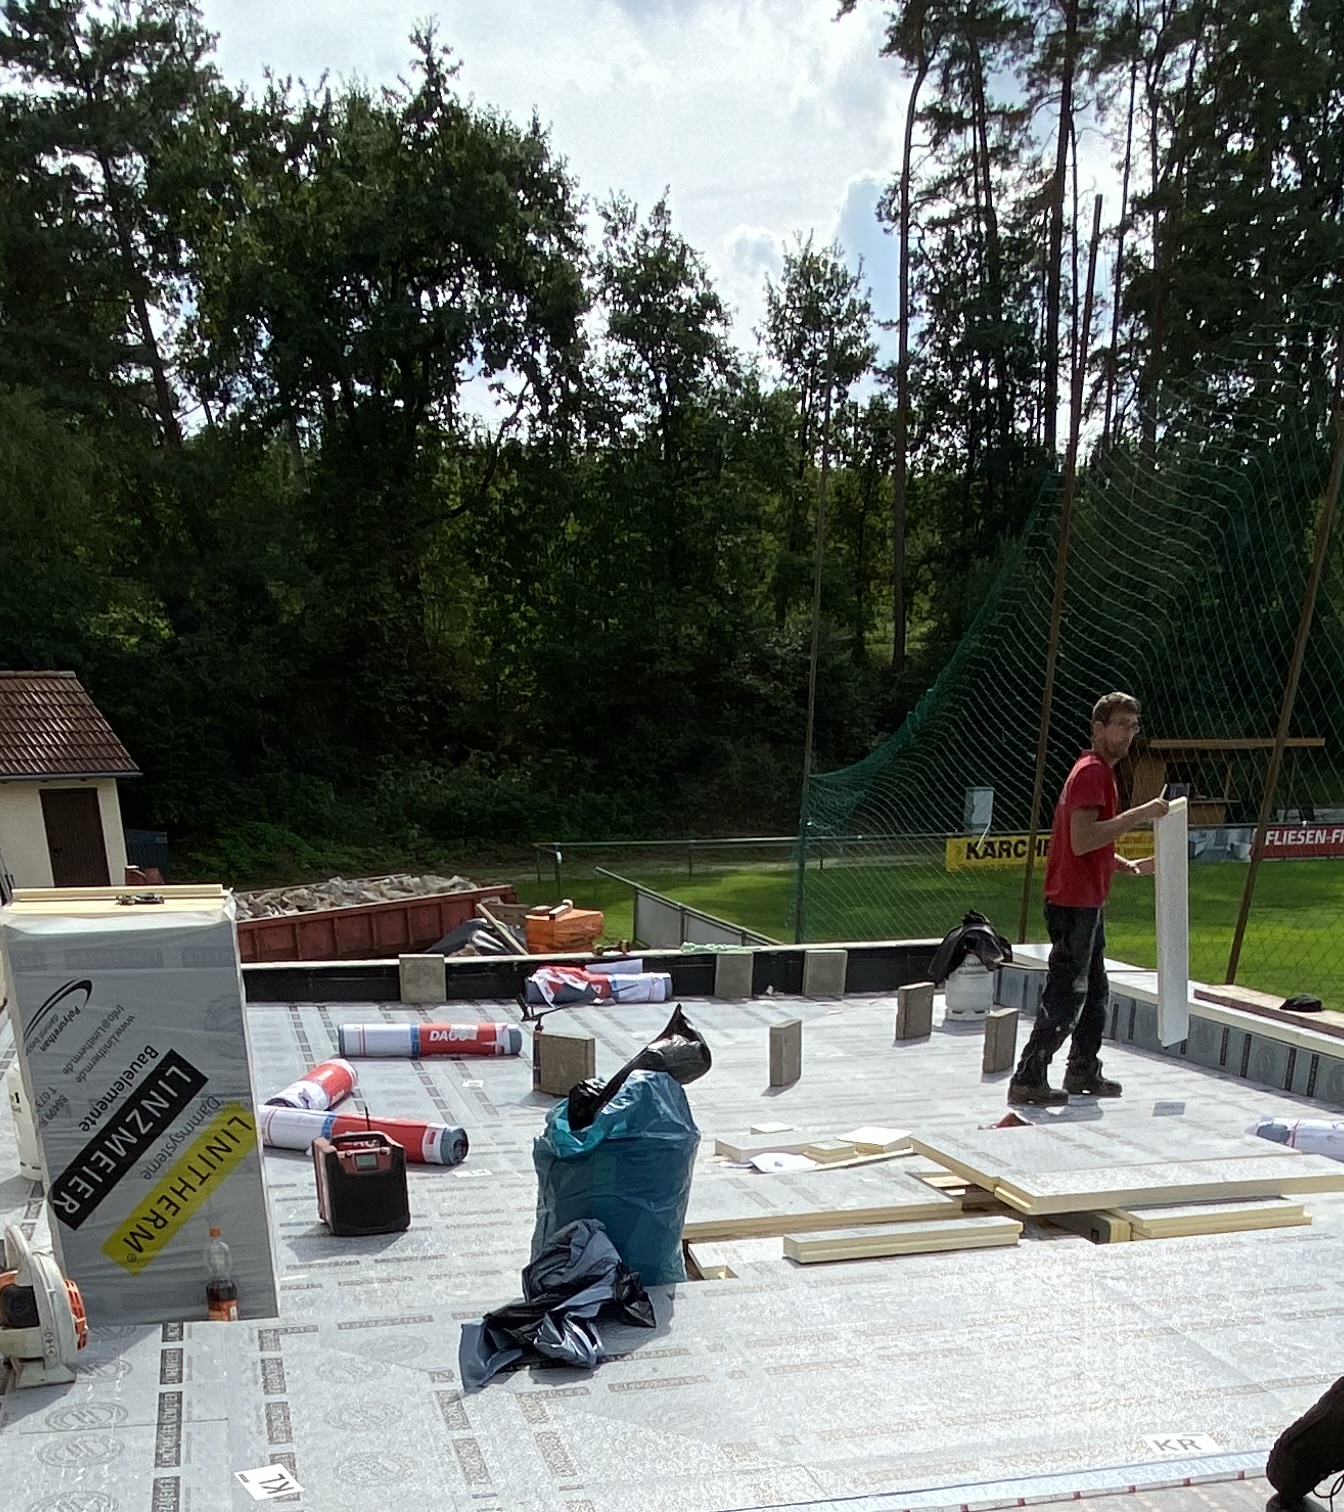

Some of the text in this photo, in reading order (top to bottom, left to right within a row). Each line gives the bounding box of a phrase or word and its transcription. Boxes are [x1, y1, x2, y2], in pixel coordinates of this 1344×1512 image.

[40, 1005, 81, 1052] Polyurethan
[79, 1044, 160, 1132] Bauelemente
[53, 1064, 192, 1216] LINZMEIER
[142, 1095, 222, 1181] Dämmsysteme
[1153, 1439, 1202, 1451] KR
[259, 1473, 295, 1495] KL
